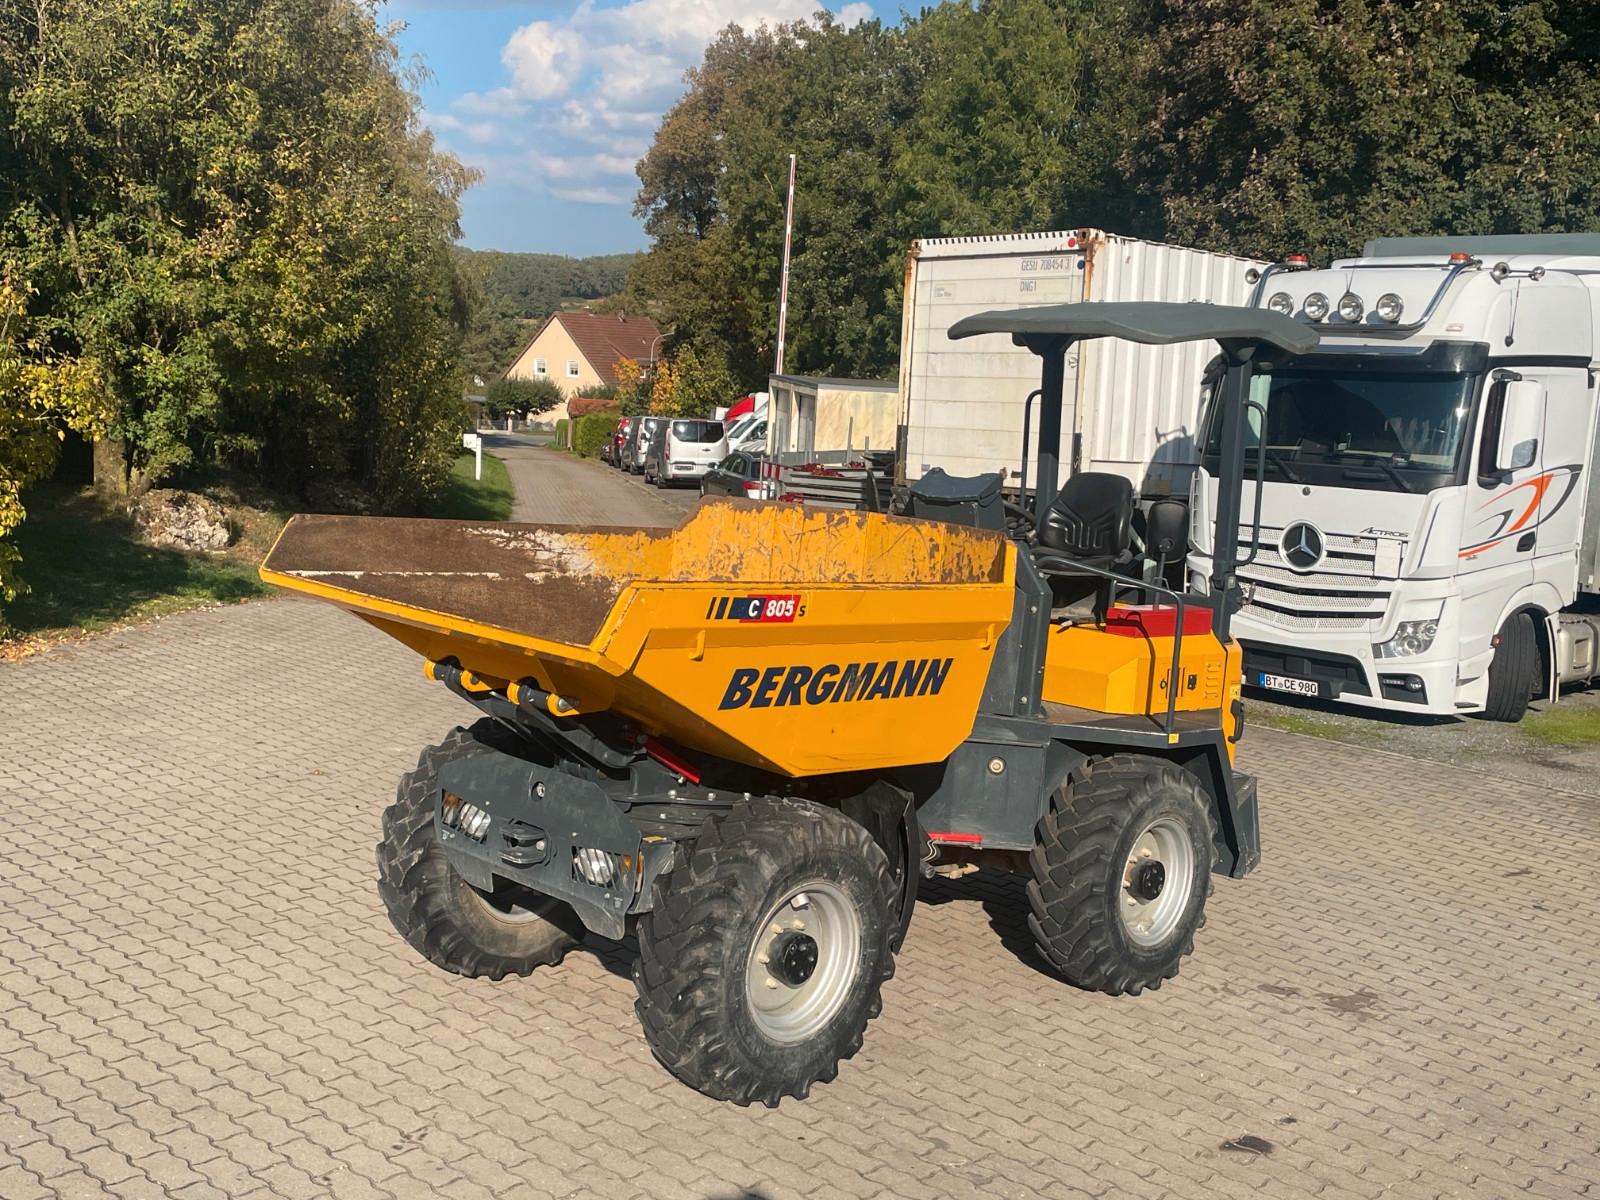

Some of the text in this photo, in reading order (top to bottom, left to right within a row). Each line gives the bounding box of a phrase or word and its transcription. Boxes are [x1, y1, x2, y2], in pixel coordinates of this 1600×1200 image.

[1021, 259, 1038, 272] GESU
[1040, 258, 1064, 271] 708454
[748, 599, 760, 618] C
[765, 599, 795, 617] 805
[717, 657, 954, 711] BERGMANN
[1265, 675, 1317, 694] BT CE 980
